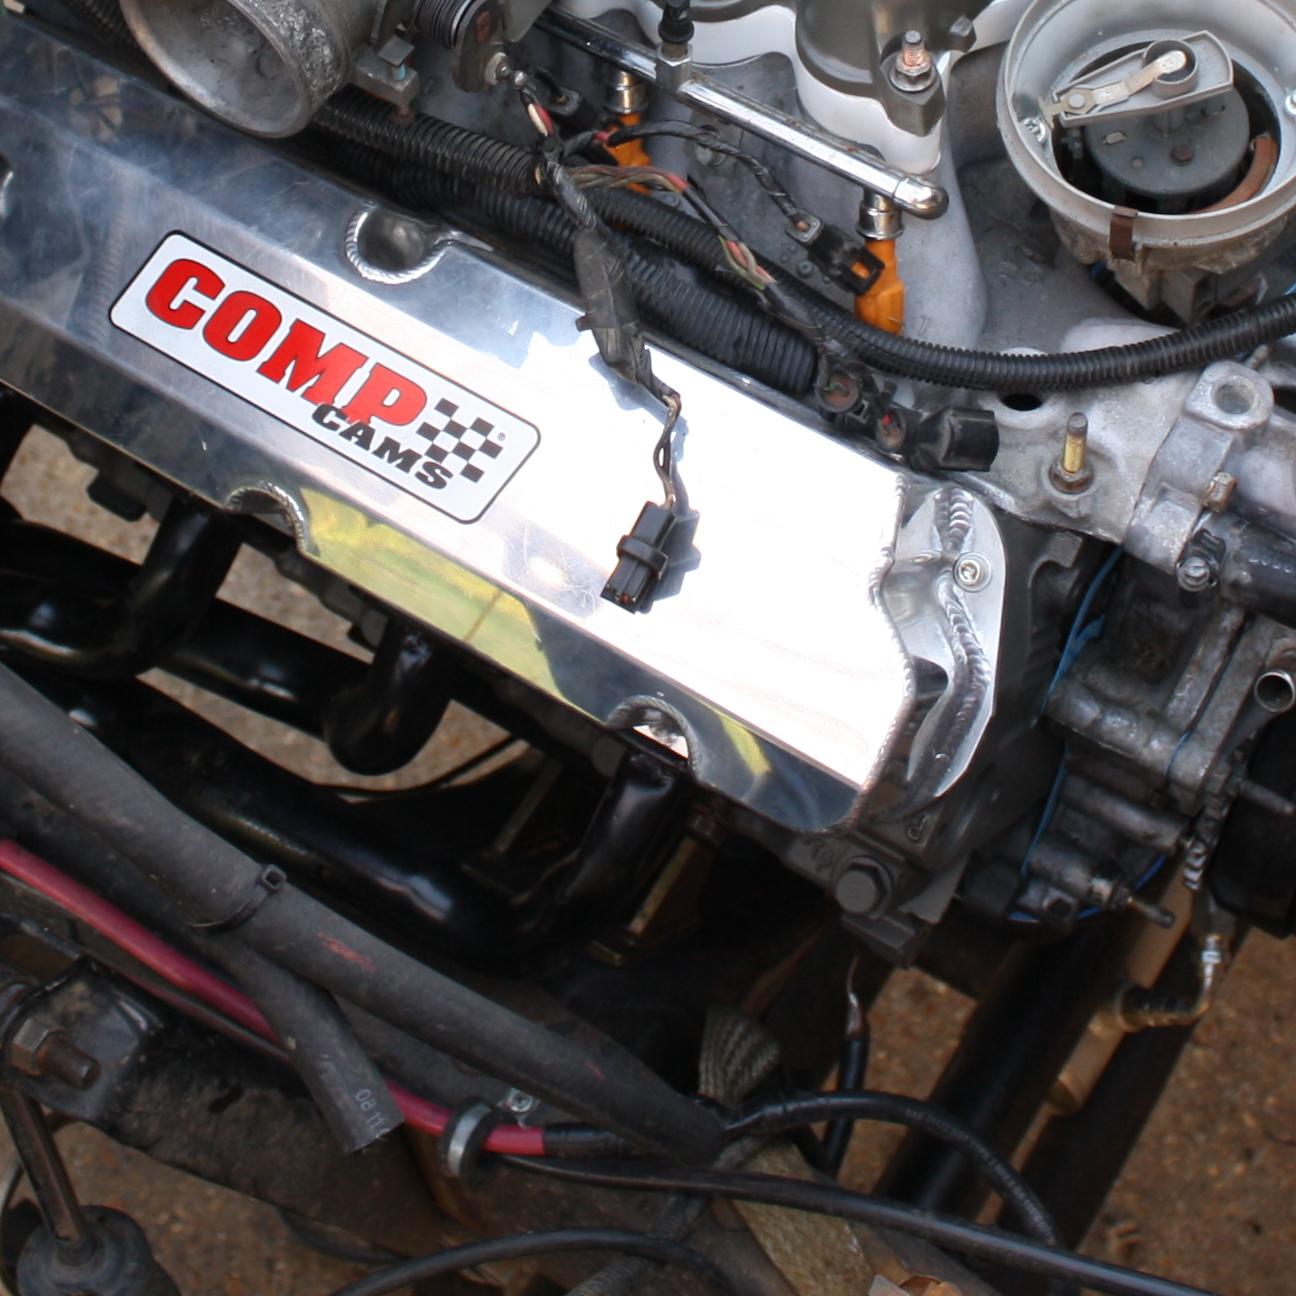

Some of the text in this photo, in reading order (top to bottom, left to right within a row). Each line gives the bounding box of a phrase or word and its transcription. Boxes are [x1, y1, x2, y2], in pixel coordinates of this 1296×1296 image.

[145, 258, 428, 428] COMP
[311, 403, 454, 490] CAMS
[355, 1088, 376, 1111] 08
